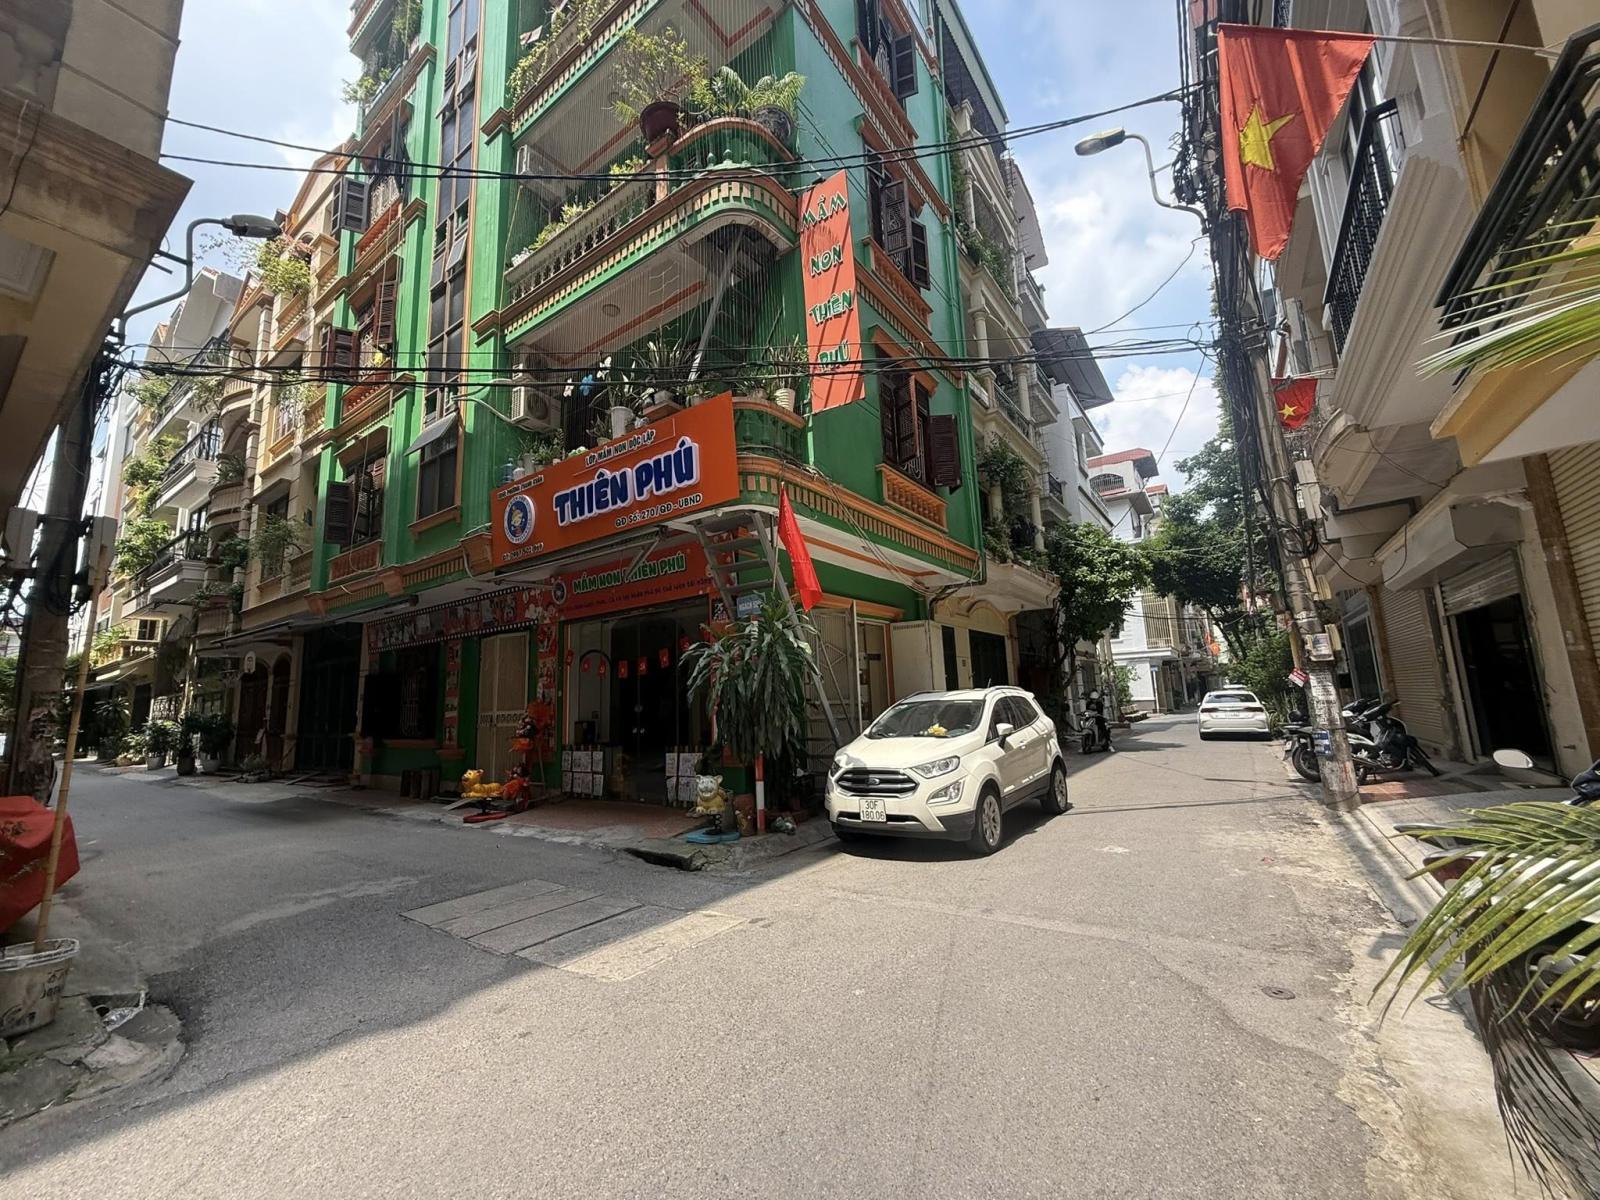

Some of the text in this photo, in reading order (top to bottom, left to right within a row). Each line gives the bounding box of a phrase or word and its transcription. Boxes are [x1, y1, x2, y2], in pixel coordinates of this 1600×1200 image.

[810, 244, 842, 276] NON
[809, 289, 853, 325] THIÊN
[553, 467, 632, 526] THIÊN
[633, 436, 699, 500] PHÚ
[677, 493, 703, 509] UBND
[598, 569, 622, 588] NON
[659, 551, 686, 575] PHÚ
[861, 810, 885, 820] 180.06
[865, 800, 878, 810] 30F
